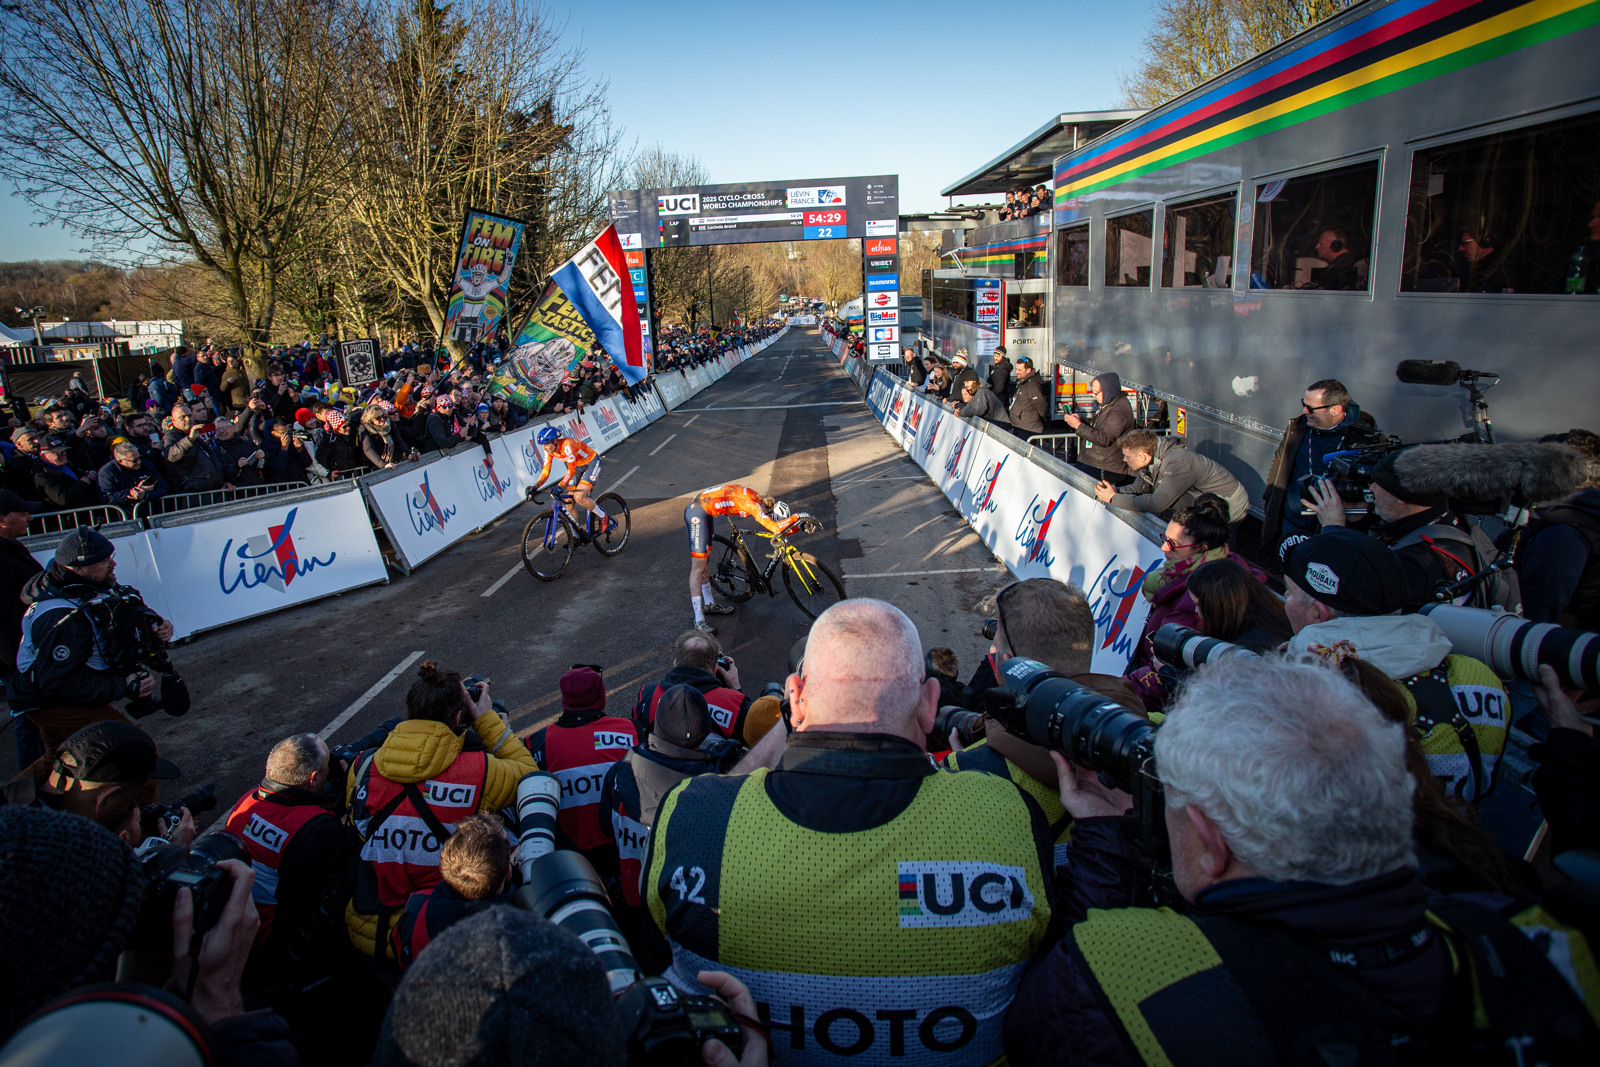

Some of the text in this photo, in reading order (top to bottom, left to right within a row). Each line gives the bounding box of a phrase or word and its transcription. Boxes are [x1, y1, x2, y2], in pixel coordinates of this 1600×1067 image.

[718, 193, 765, 202] CYCLO-CROSS
[791, 190, 810, 198] LIÉVIN
[791, 197, 815, 205] FRANCE
[665, 197, 696, 211] UCI
[728, 199, 783, 208] CHAMPIONSHIPS
[809, 213, 841, 223] 54:29
[468, 217, 515, 249] FEM
[818, 228, 832, 237] 22
[474, 237, 491, 247] ON
[871, 240, 891, 253] ethias
[462, 244, 506, 272] FIRE
[626, 253, 639, 265] hias
[870, 312, 896, 320] BigMat
[350, 343, 370, 353] PHOTO
[591, 405, 617, 429] BigMat
[1279, 534, 1310, 563] OUBAIX
[1457, 692, 1504, 720] UCI
[601, 734, 631, 747] UCI
[560, 774, 602, 798] HOT
[431, 785, 471, 804] UCI
[251, 820, 283, 848] UCI
[370, 828, 441, 852] HOTO
[670, 866, 706, 905] 42
[922, 872, 1024, 916] UCI
[757, 1001, 978, 1056] HOTO
